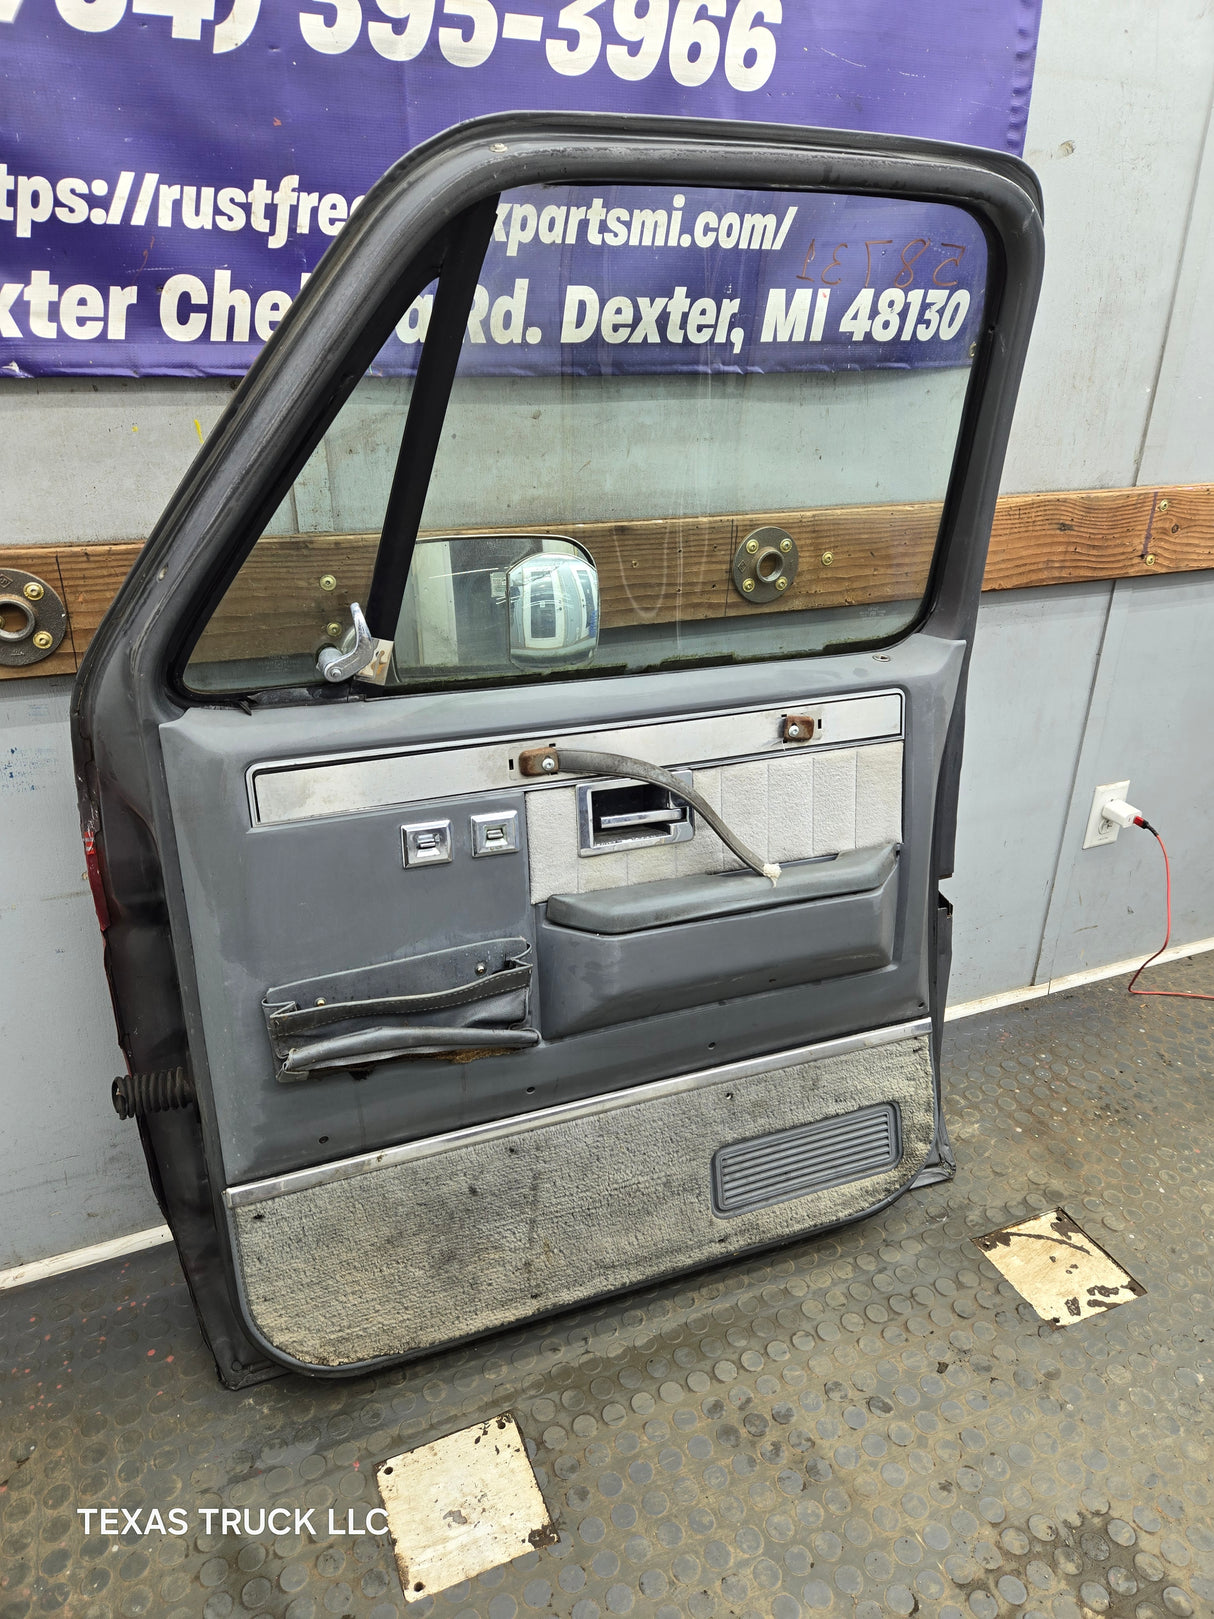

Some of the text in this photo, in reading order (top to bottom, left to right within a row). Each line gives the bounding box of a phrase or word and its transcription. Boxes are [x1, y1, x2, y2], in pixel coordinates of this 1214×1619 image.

[560, 285, 745, 354] Dexter,
[760, 288, 831, 342] MI
[839, 287, 971, 342] 48130
